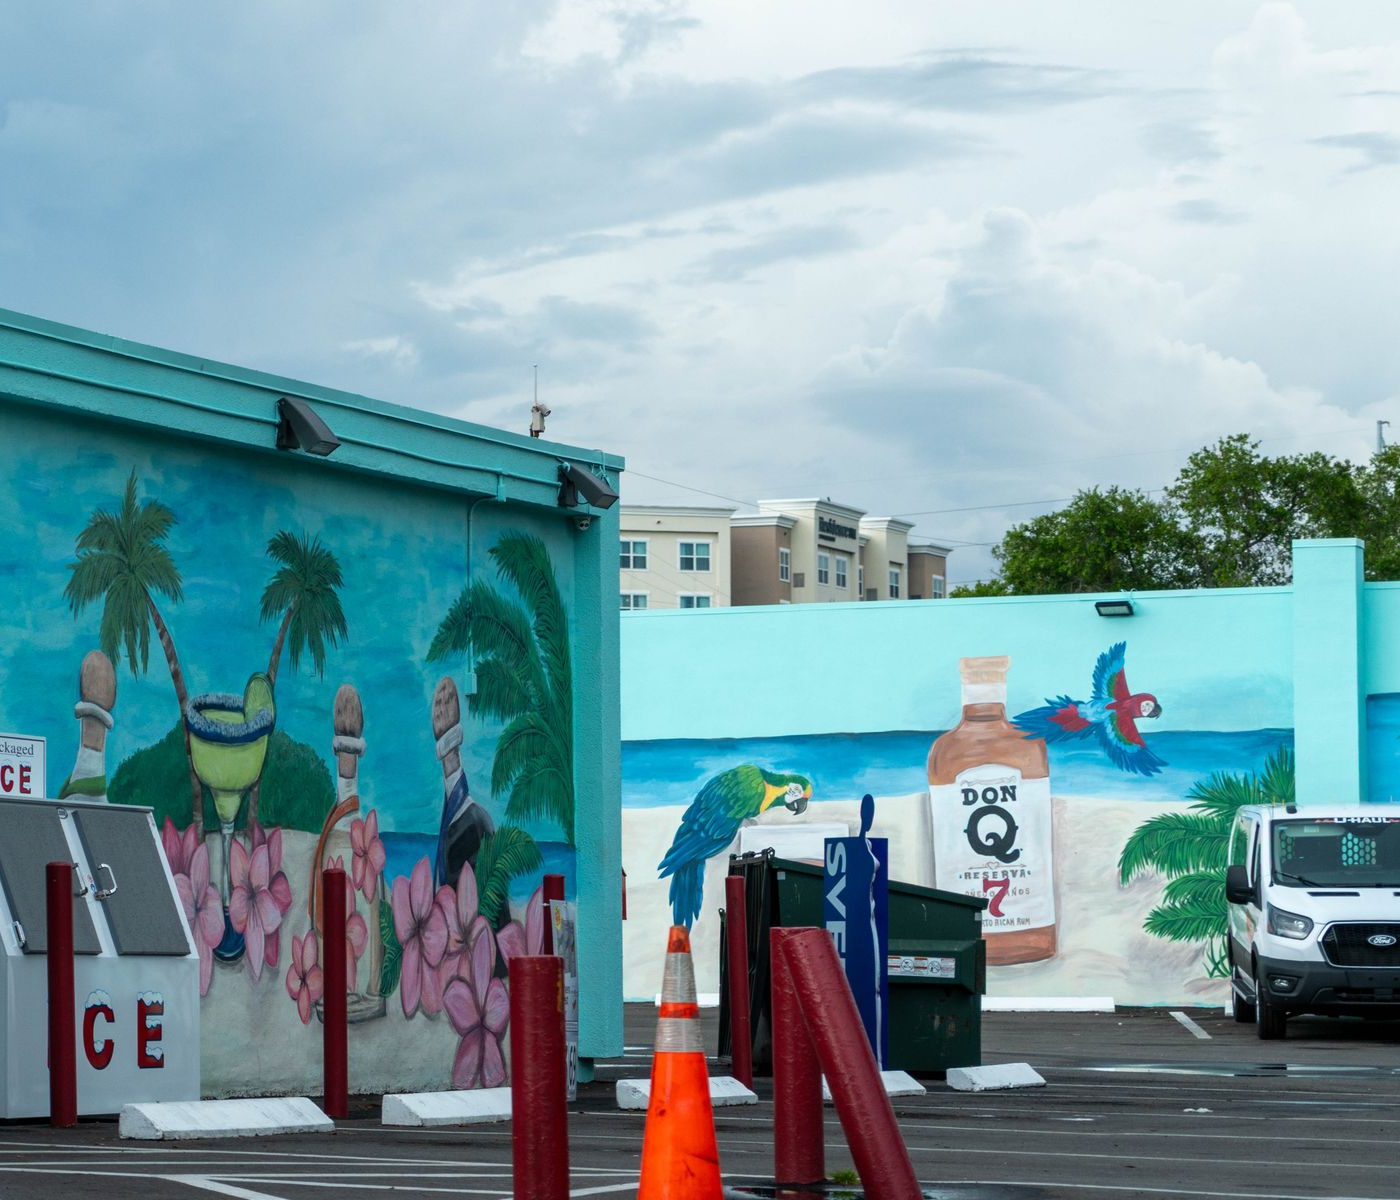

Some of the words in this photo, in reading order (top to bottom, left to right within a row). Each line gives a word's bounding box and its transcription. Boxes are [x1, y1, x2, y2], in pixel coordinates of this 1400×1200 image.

[961, 785, 1017, 806] DON
[963, 804, 1024, 864] Q
[964, 869, 1026, 880] RESERVA
[825, 841, 847, 972] SVE
[982, 877, 1011, 918] 7
[1373, 936, 1391, 944] Ford
[82, 989, 165, 1070] CE
